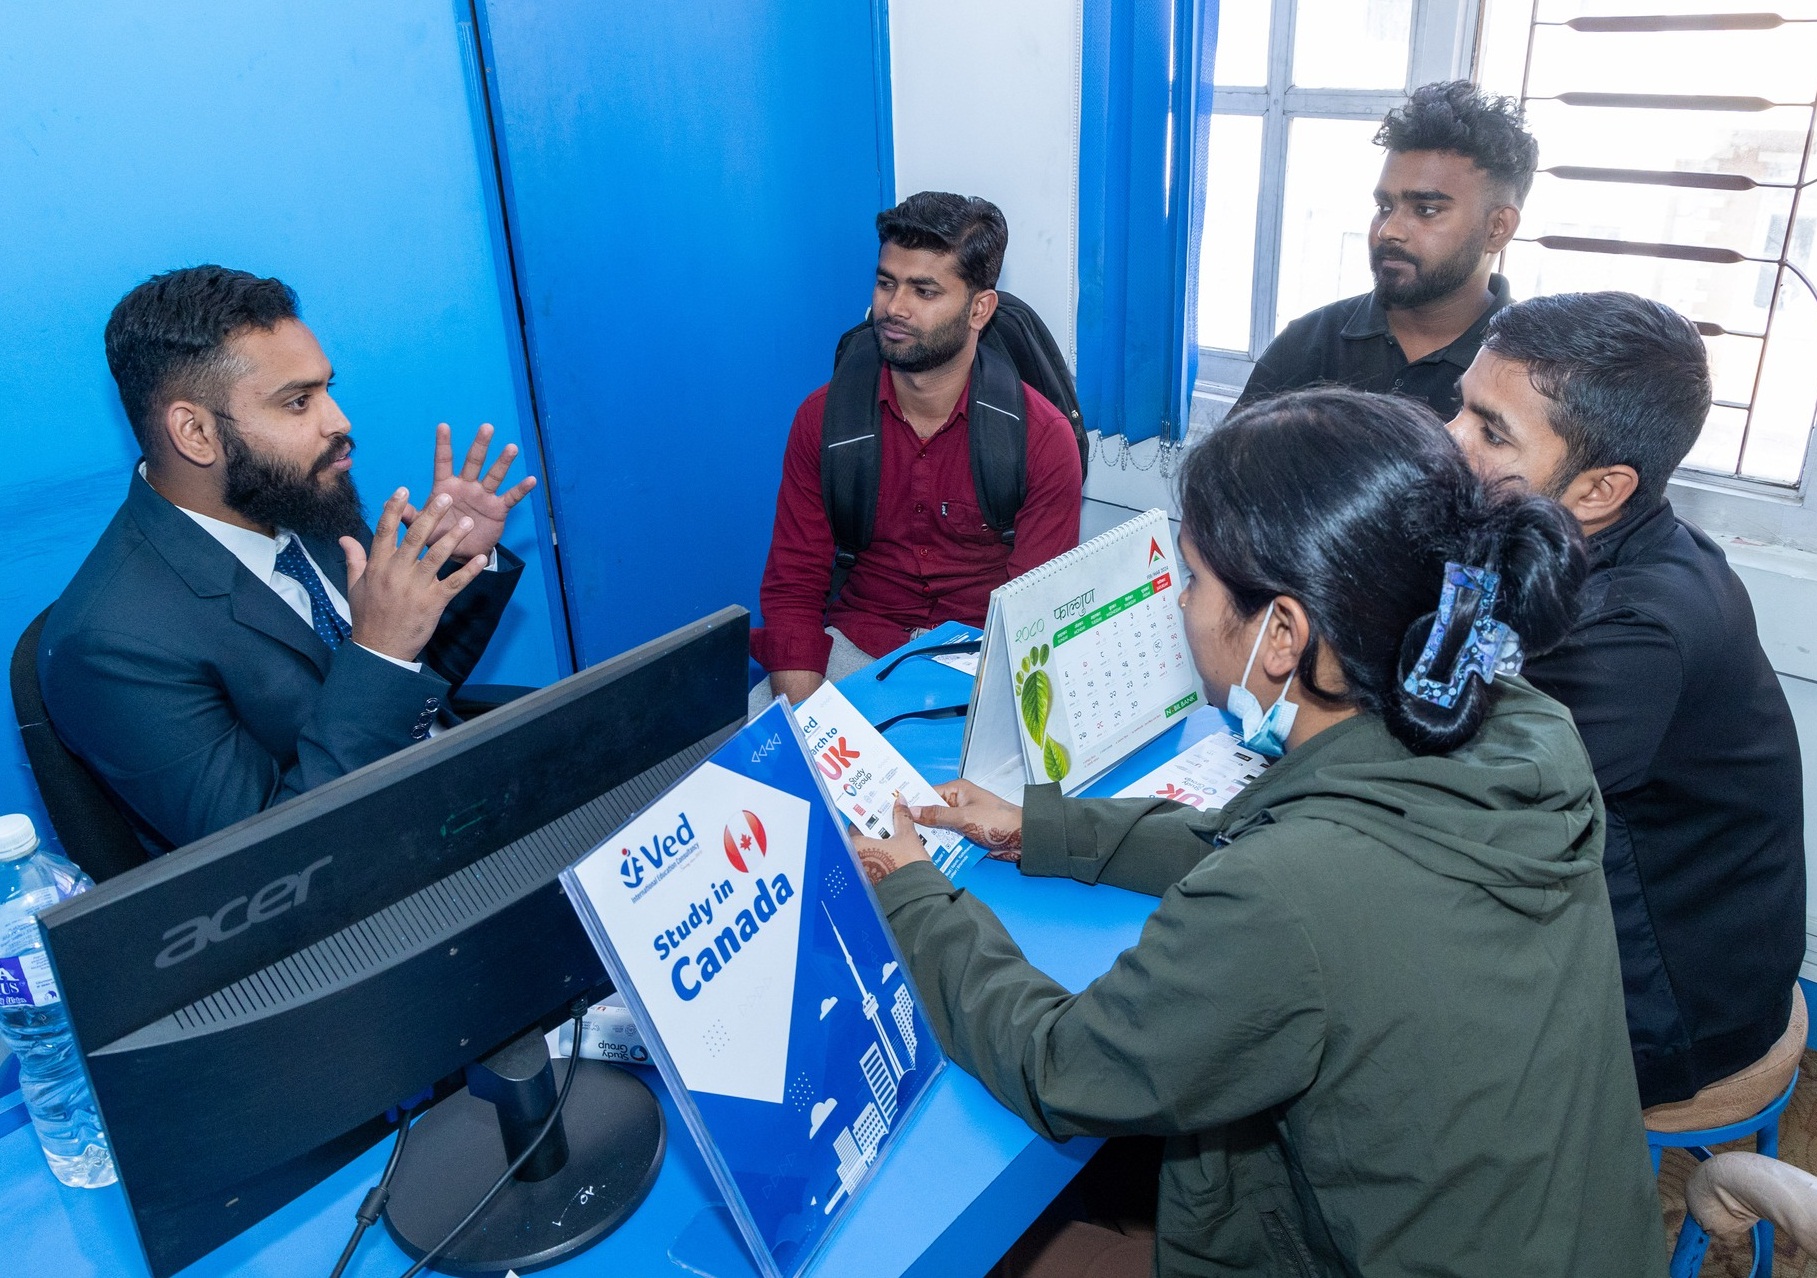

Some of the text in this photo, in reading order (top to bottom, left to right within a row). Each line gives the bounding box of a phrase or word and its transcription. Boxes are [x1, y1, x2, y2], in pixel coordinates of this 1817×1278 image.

[804, 716, 818, 737] ed
[811, 737, 829, 755] arch
[826, 728, 838, 738] to
[816, 737, 860, 780] UK
[849, 768, 866, 785] Study
[855, 772, 872, 790] Group
[639, 812, 695, 869] Ved
[656, 861, 678, 881] Education
[155, 855, 333, 969] acer
[654, 879, 734, 960] Study in
[671, 873, 794, 1001] Canada
[0, 982, 19, 995] US
[598, 1040, 628, 1053] Group
[602, 1049, 629, 1060] Study
